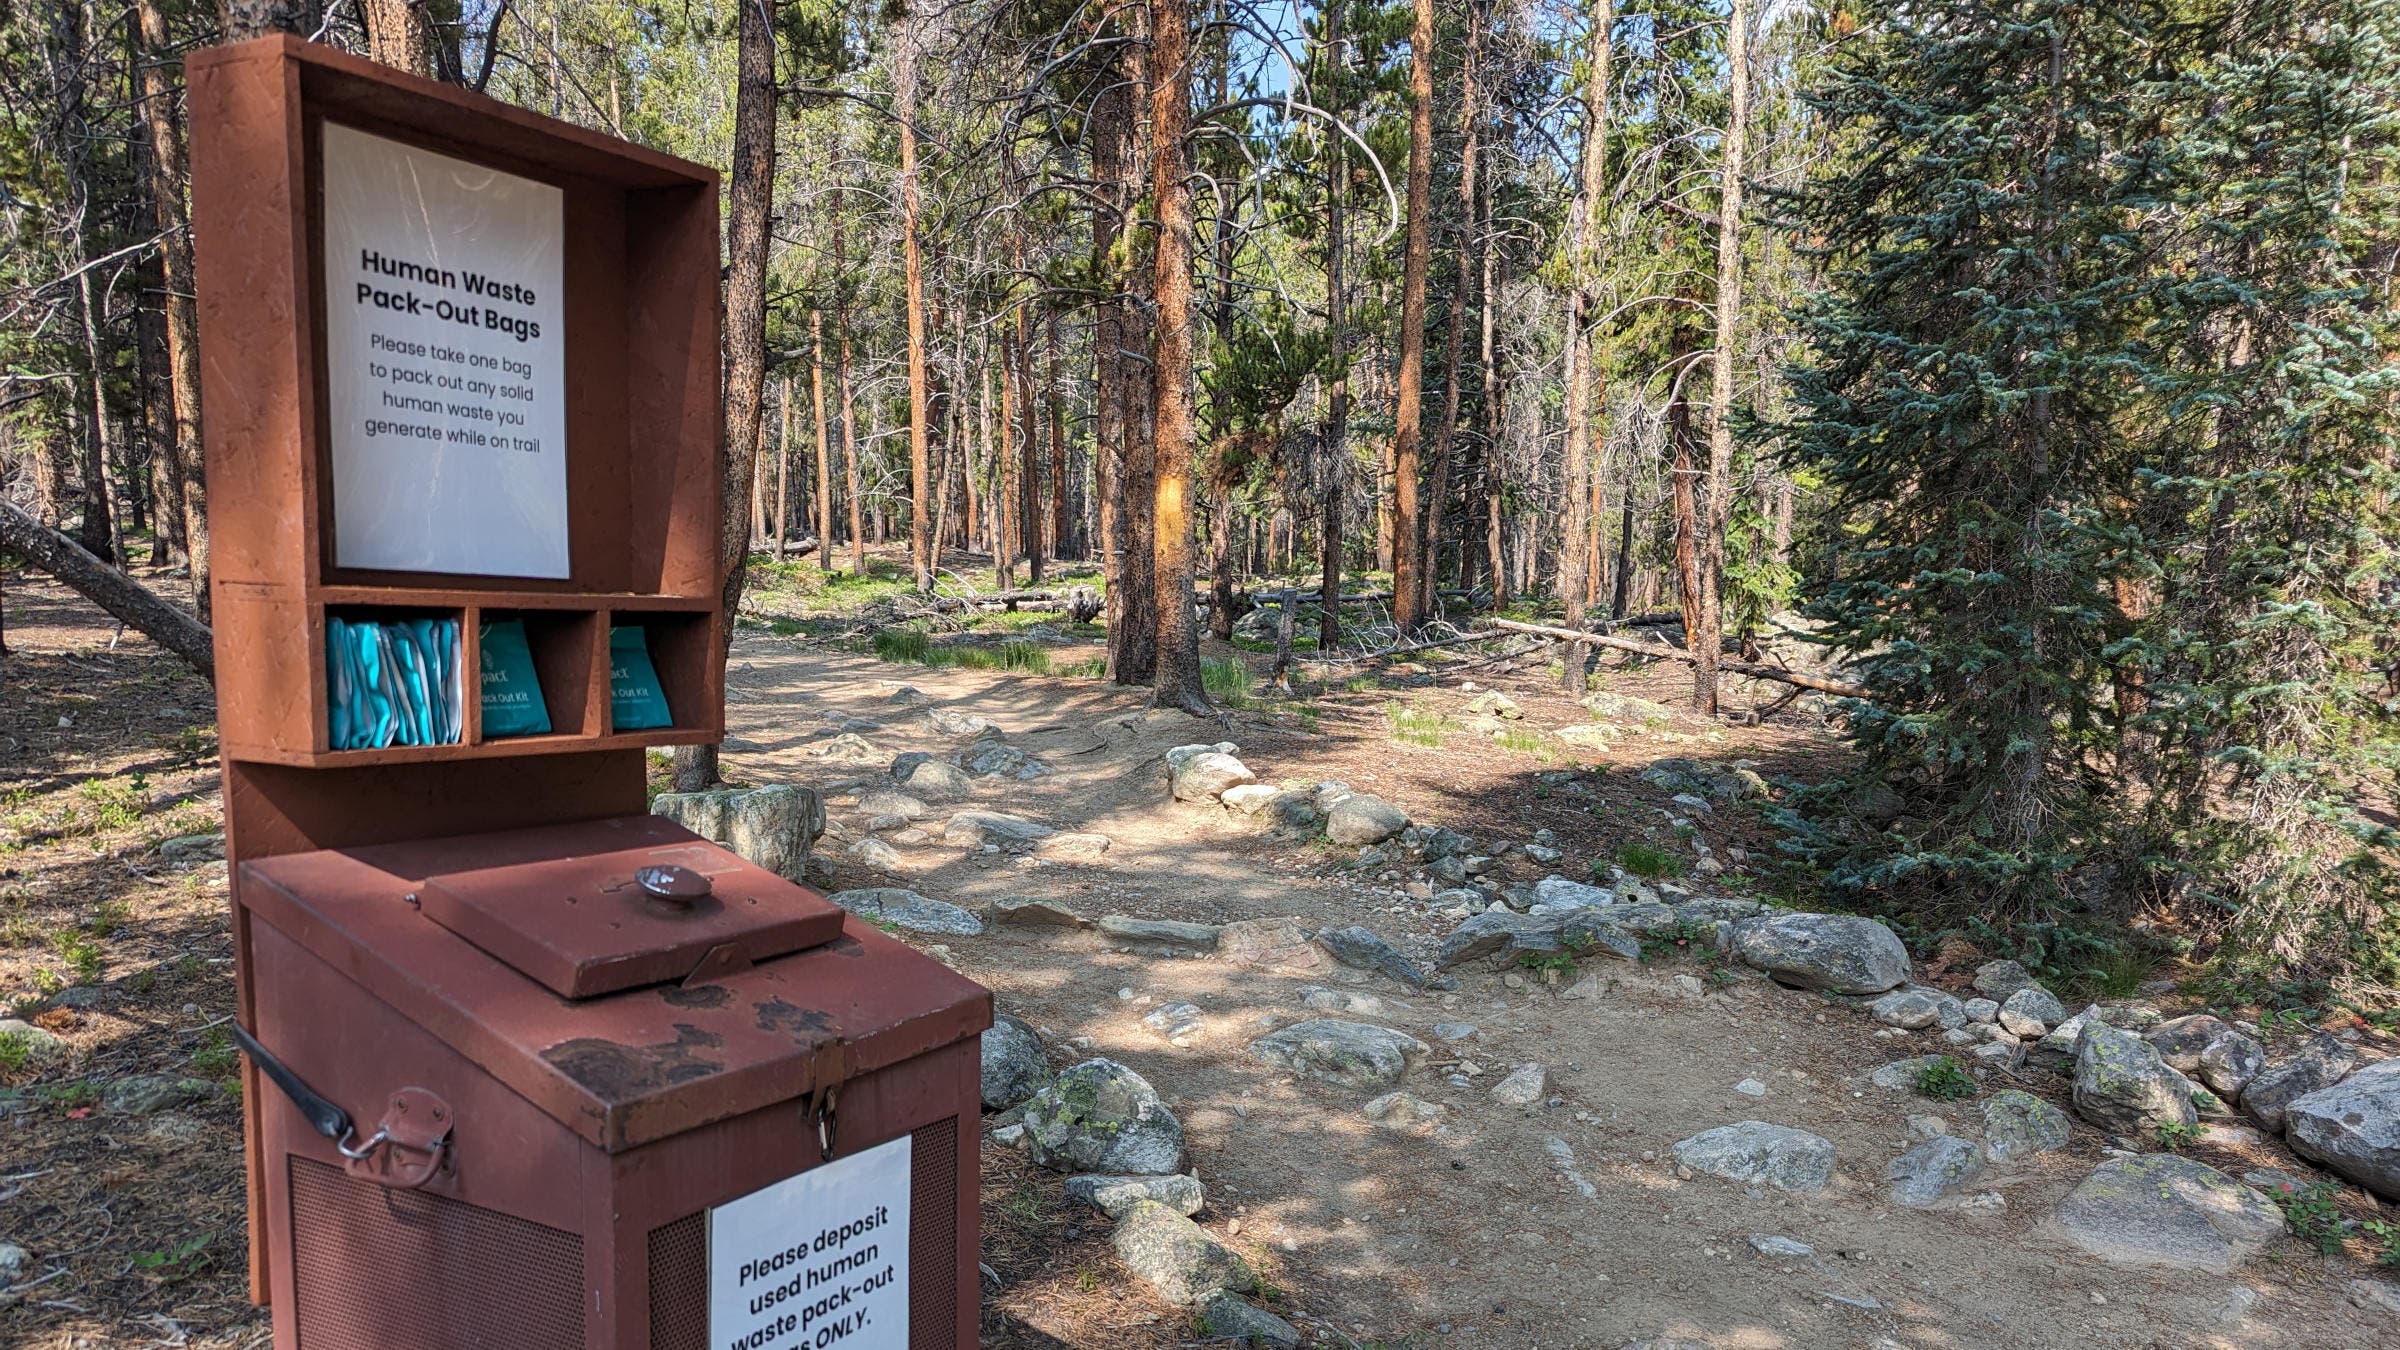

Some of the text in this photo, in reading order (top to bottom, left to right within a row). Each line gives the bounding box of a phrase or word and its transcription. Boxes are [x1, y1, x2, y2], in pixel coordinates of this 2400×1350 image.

[361, 249, 536, 306] Human Waste
[357, 282, 541, 343] Pack-Out Bags
[370, 362, 534, 402] to pack out any solid
[371, 333, 532, 380] Please take one bag
[383, 390, 524, 427] human waste you
[365, 419, 540, 453] generate while on trail
[739, 1205, 888, 1288] Please deposit
[749, 1244, 879, 1315] used human
[802, 1264, 895, 1332] pack-out
[816, 1306, 872, 1349] ONLY.
